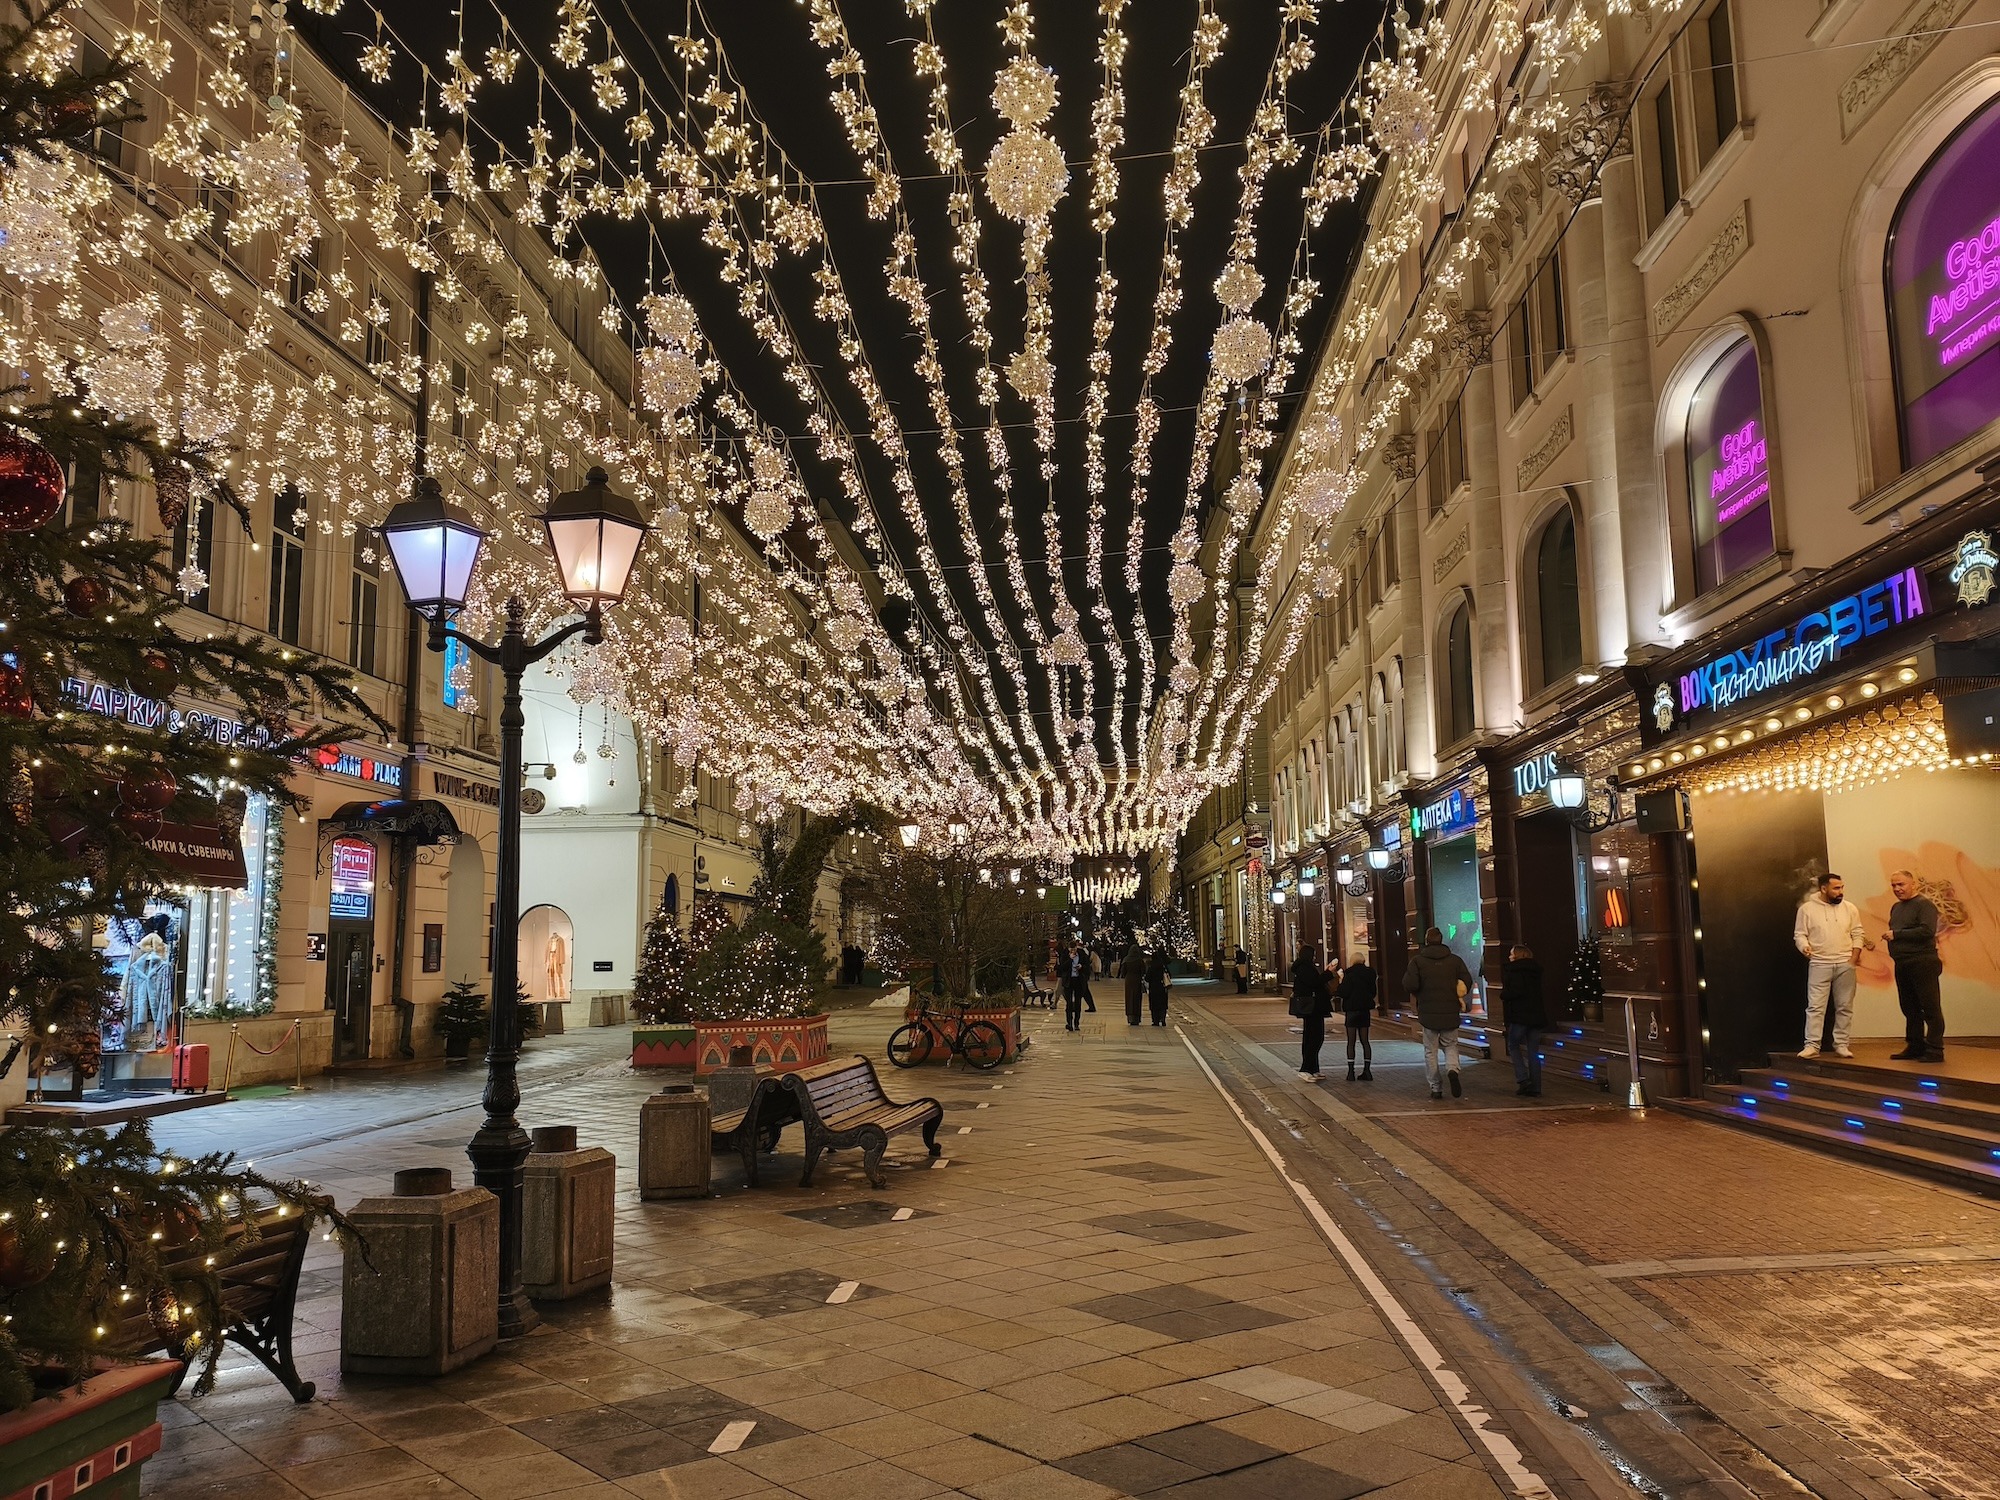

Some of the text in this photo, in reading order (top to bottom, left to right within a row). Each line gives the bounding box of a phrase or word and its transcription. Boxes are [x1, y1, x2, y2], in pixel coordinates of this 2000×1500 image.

[1942, 323, 1987, 365] Империя
[1721, 420, 1755, 462] Goar
[1718, 498, 1743, 523] Империя
[167, 709, 182, 734] &
[374, 761, 401, 786] PLACE
[1422, 798, 1453, 832] АПТЕКА
[178, 841, 189, 857] &
[188, 843, 235, 862] СУВЕНИРЫ
